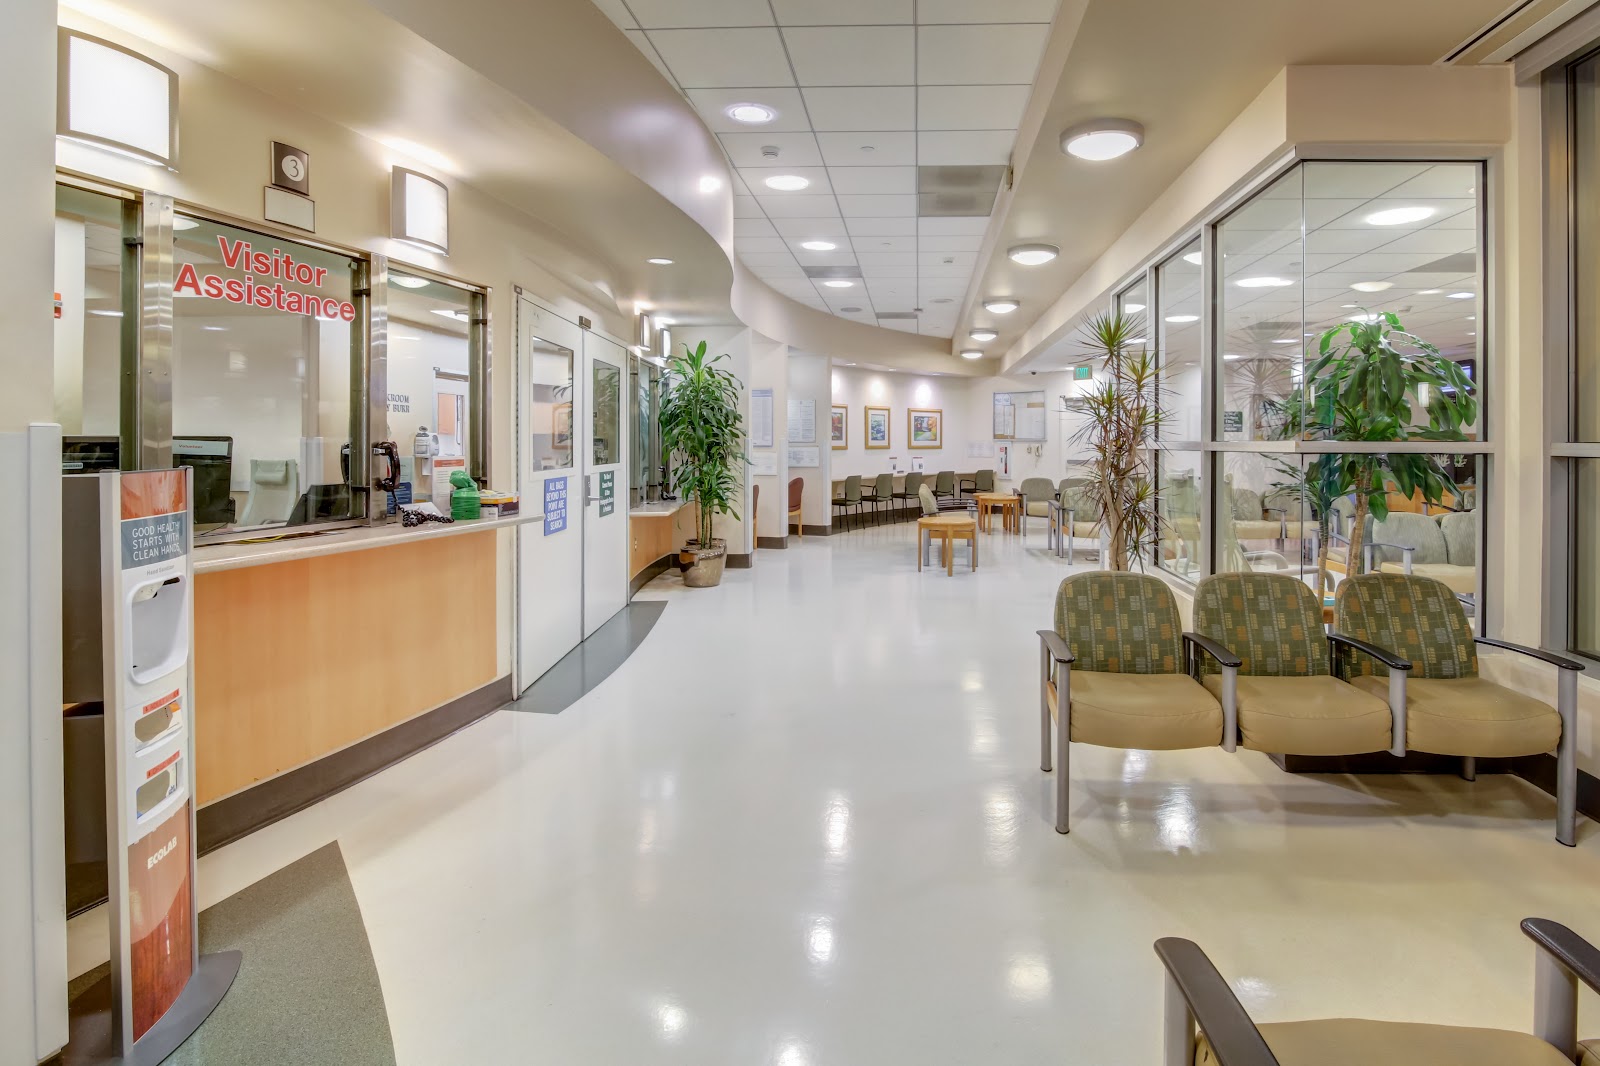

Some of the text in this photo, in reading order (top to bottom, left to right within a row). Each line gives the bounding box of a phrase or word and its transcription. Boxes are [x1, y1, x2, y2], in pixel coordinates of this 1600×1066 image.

[289, 159, 299, 178] 3
[217, 235, 328, 287] Visitor
[173, 262, 355, 322] Assistance
[1075, 367, 1089, 379] EXIT
[556, 481, 564, 490] BAGS
[546, 491, 559, 501] BEYOND
[548, 501, 558, 511] POINT
[547, 509, 566, 522] SUBJECT TO
[132, 521, 180, 538] GOOD HEALTH
[550, 520, 562, 530] SEARCH
[132, 532, 180, 550] STARTS WITH
[133, 547, 159, 561] CLEAN
[148, 836, 177, 870] ECOLAB
